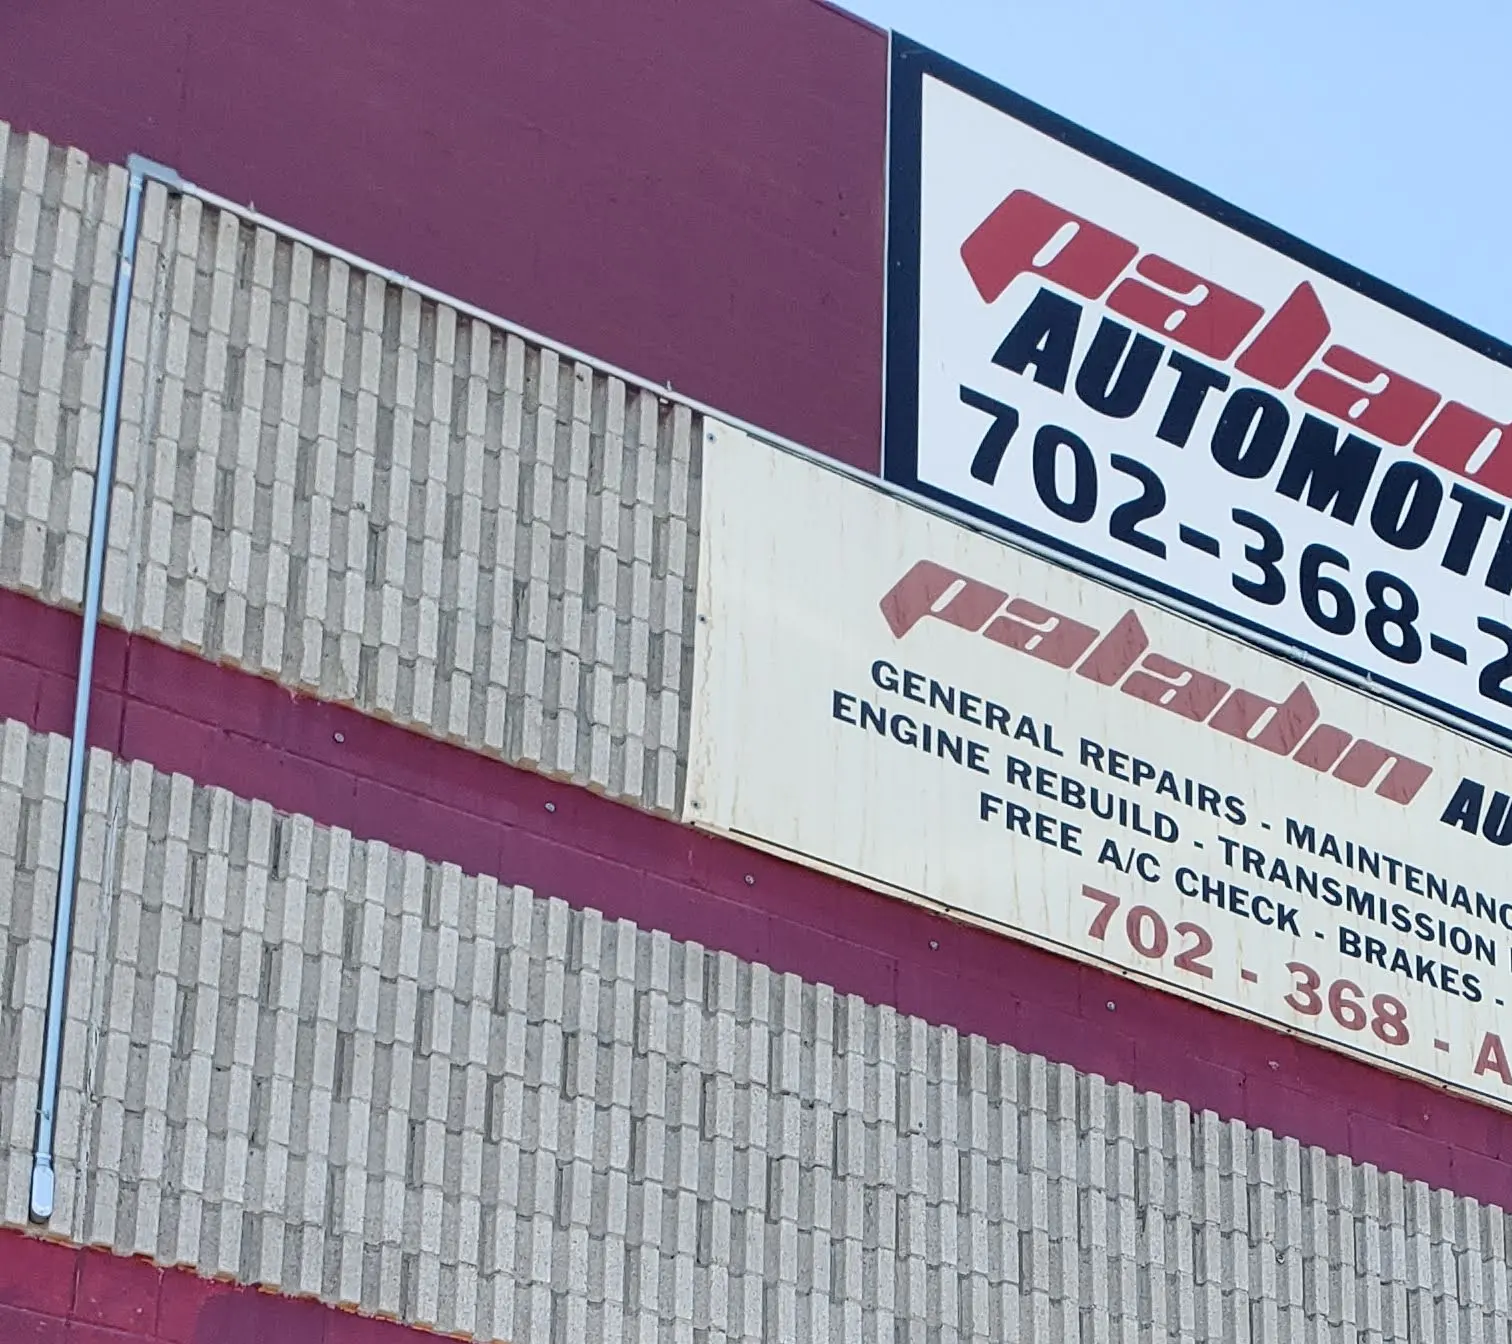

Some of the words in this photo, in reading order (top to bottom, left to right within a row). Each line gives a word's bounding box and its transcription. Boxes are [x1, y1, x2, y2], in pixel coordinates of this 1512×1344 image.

[871, 659, 1064, 757] GENERAL
[1079, 738, 1248, 826] REPAIRS
[880, 559, 1433, 806] paladin
[832, 690, 991, 775] ENGINE
[1006, 754, 1180, 845] REBUILD
[1218, 835, 1497, 967] TRANSMISSION
[979, 791, 1083, 856] FREE
[1097, 839, 1162, 883] A/C
[1175, 866, 1300, 937] CHECK
[1338, 926, 1482, 1003] BRAKES
[1081, 884, 1216, 981] 702
[1284, 962, 1411, 1047] 368
